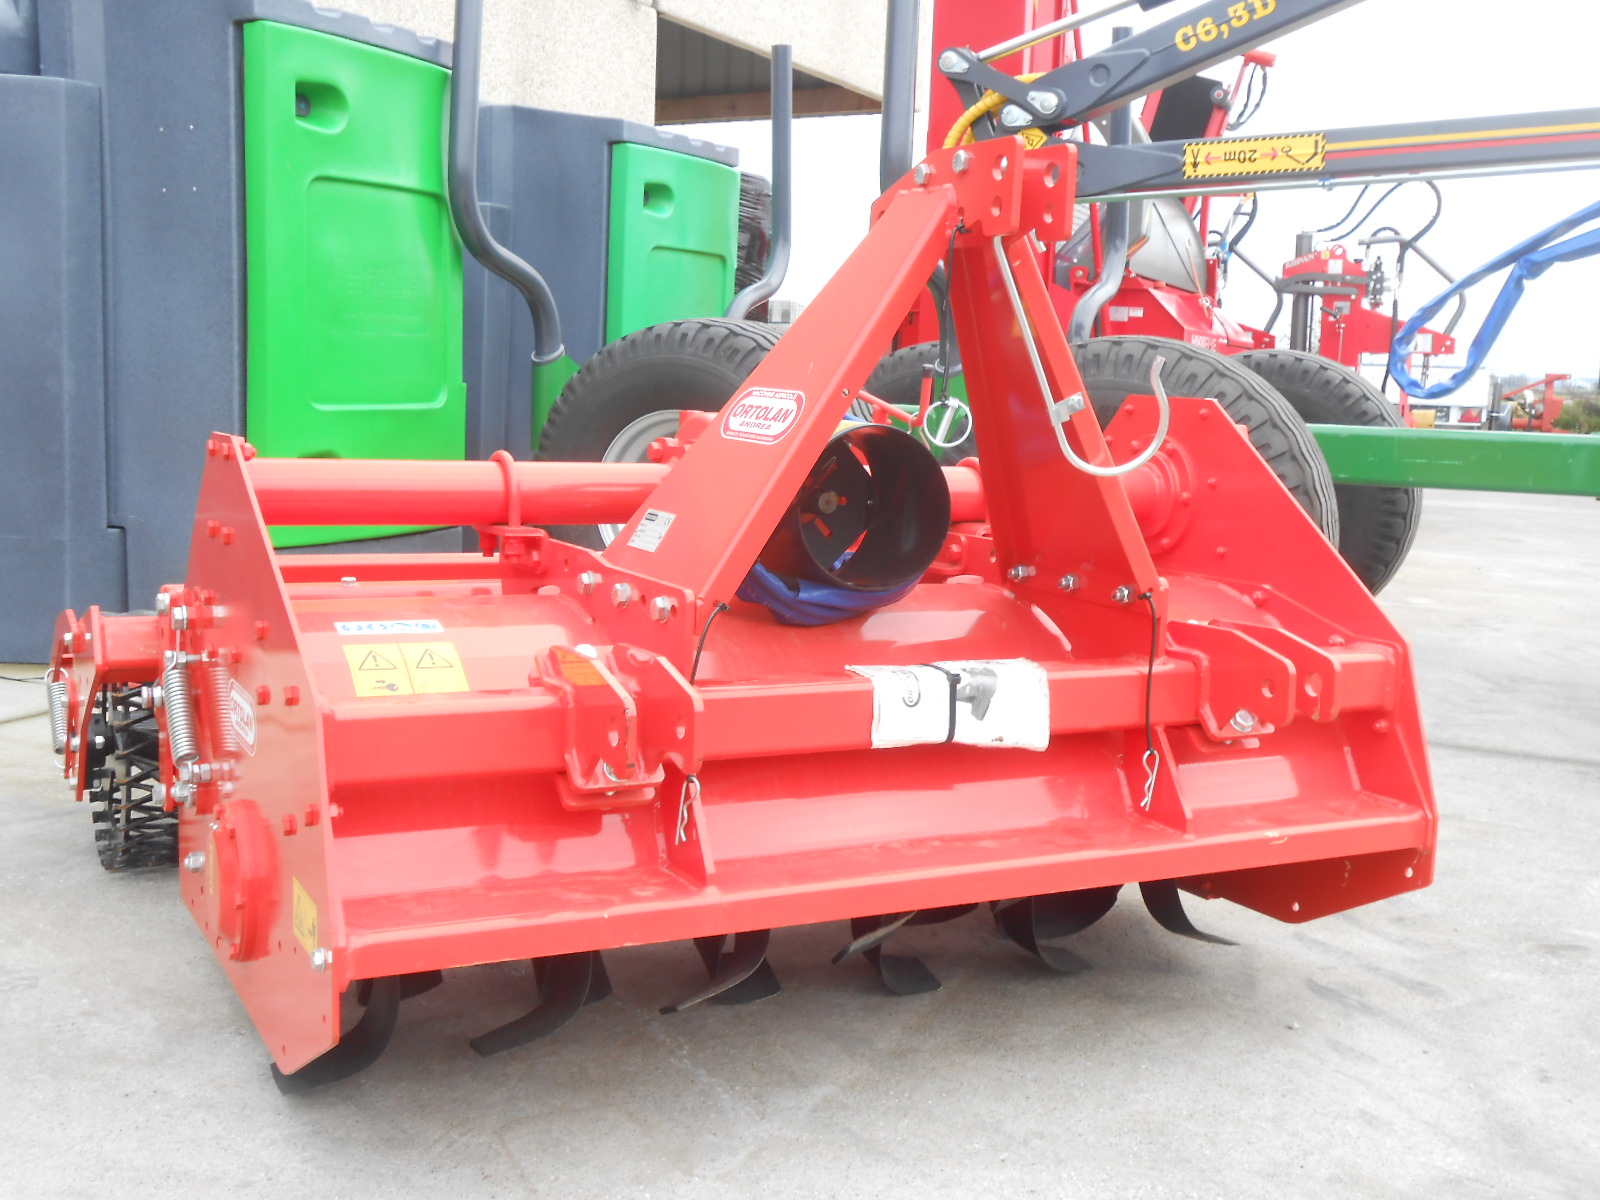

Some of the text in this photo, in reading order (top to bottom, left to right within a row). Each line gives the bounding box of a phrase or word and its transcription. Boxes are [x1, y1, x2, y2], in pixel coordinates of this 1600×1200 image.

[1175, 0, 1277, 52] C6,3D
[1223, 149, 1258, 163] 20m
[732, 403, 794, 424] ORTOLAN
[739, 420, 772, 431] ANDREA
